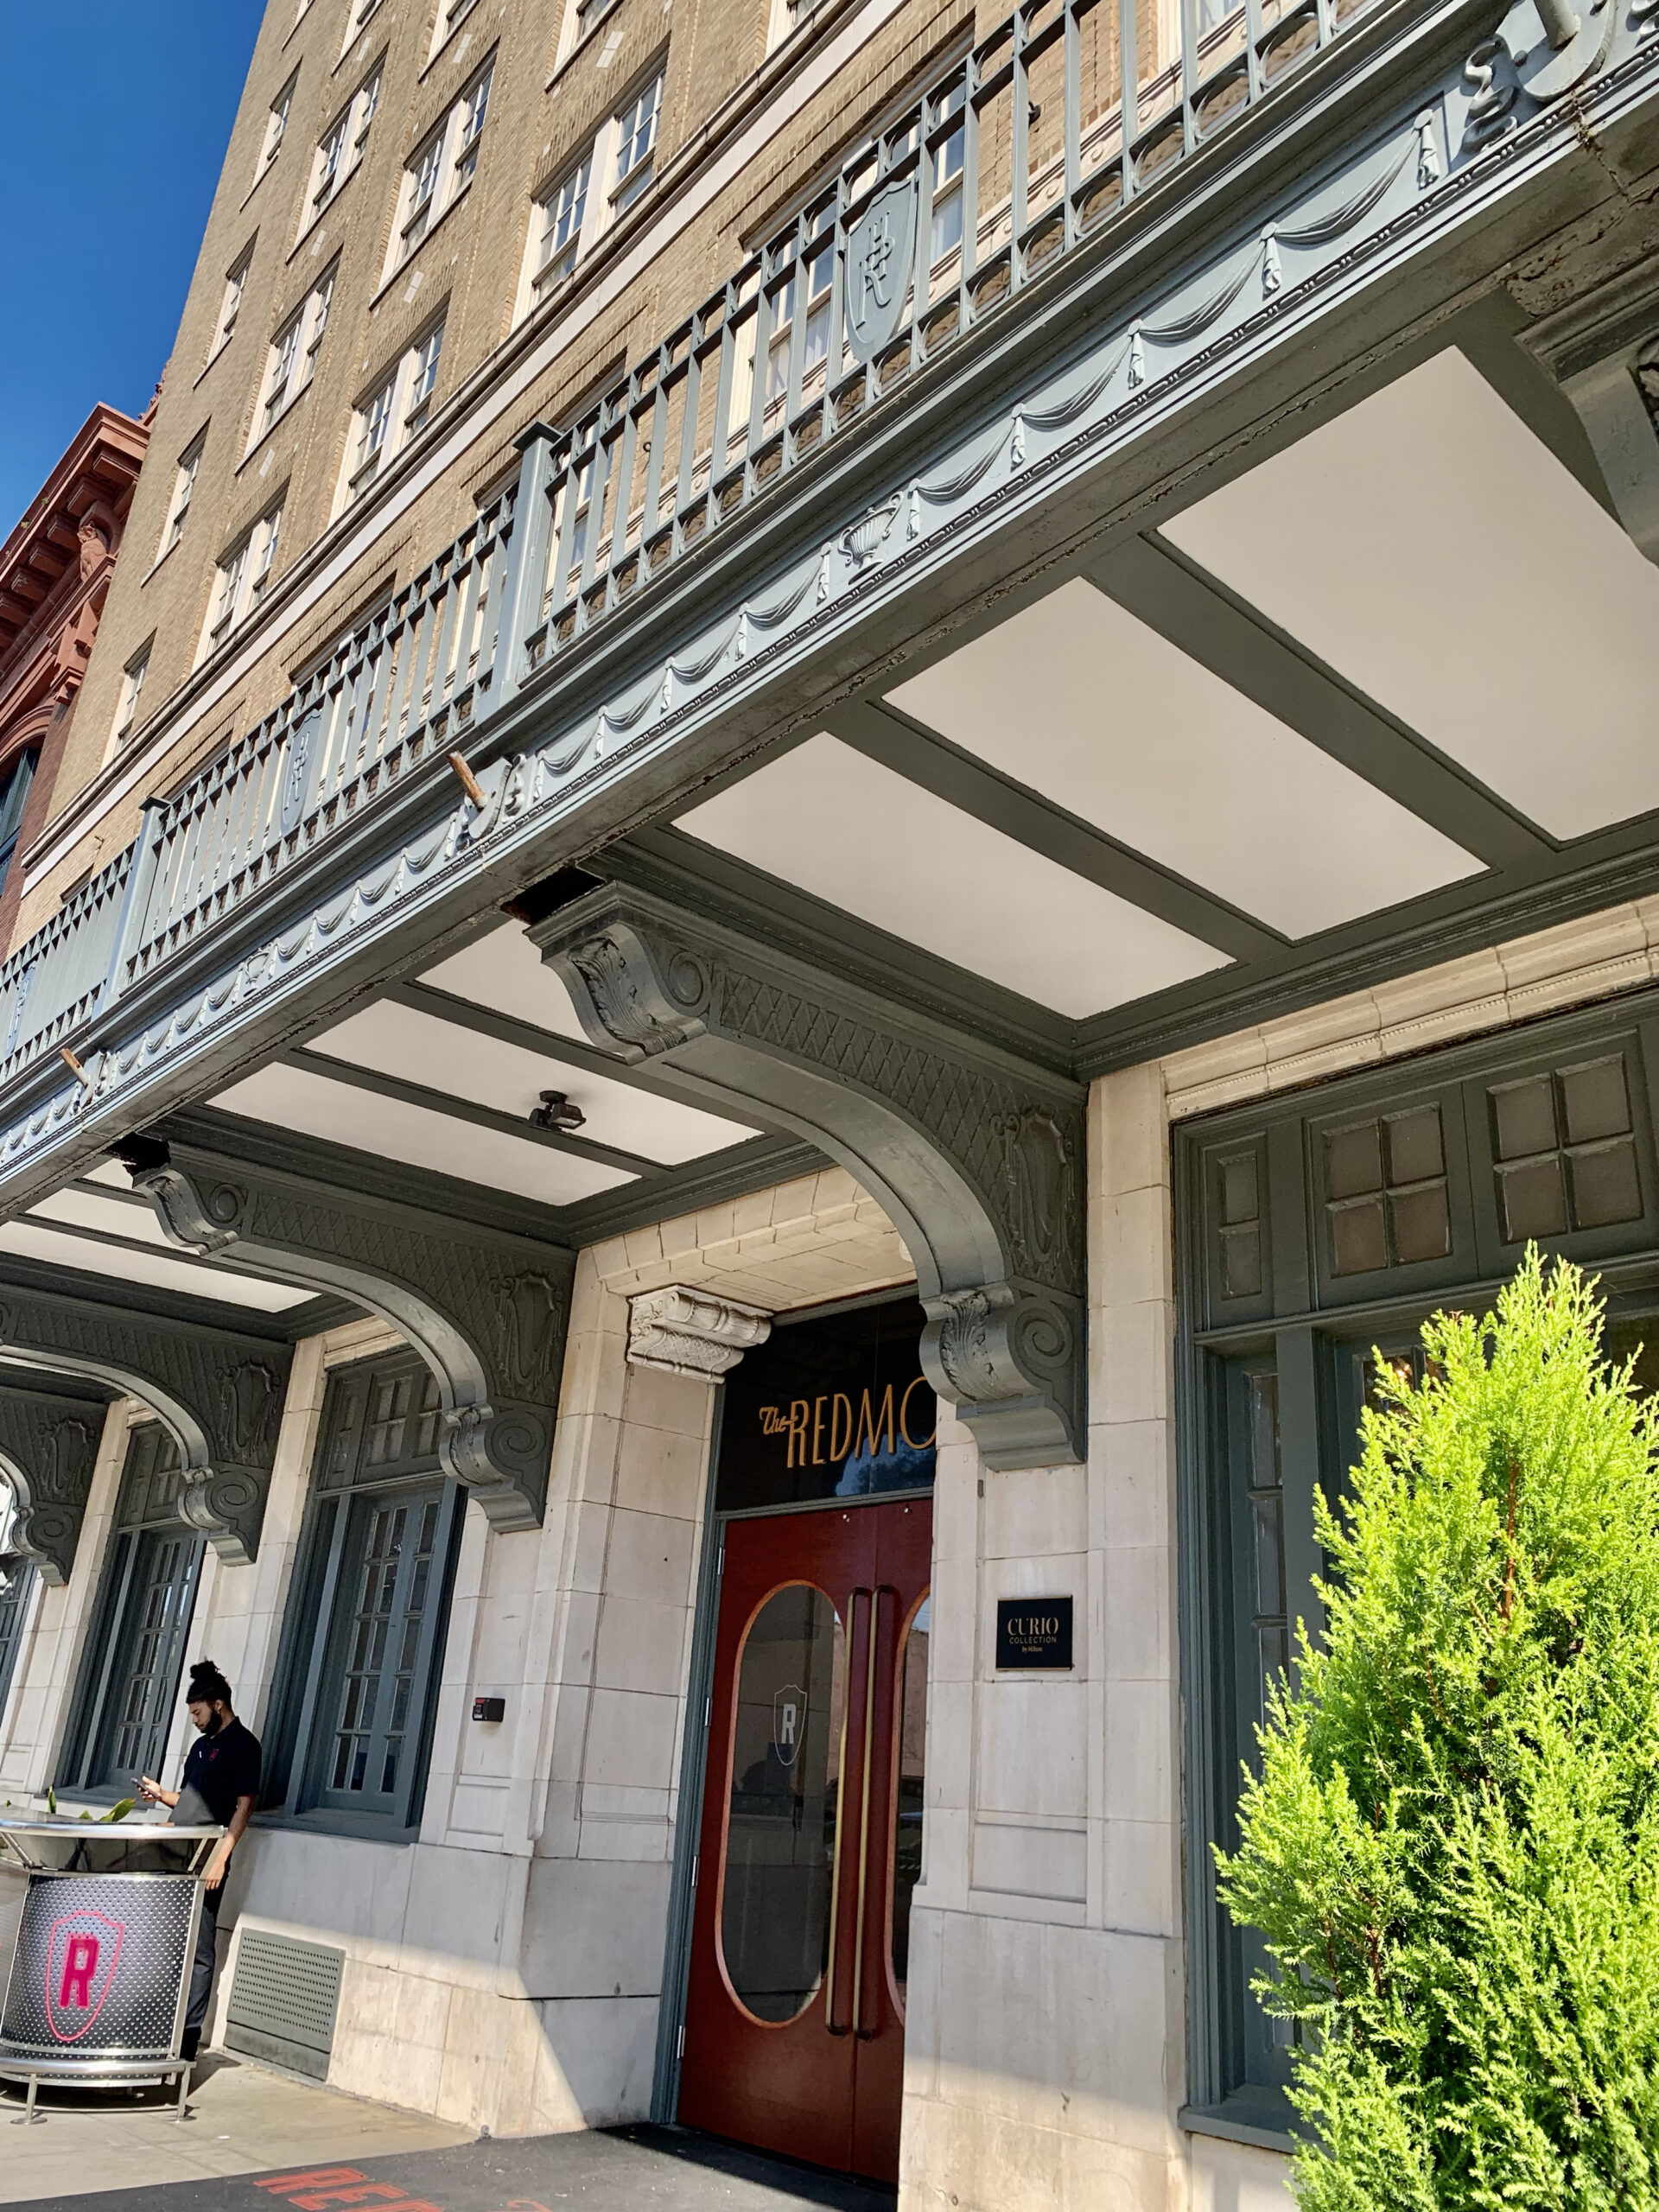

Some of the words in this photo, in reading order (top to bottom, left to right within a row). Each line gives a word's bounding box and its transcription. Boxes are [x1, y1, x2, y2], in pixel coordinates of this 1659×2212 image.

[760, 1406, 798, 1435] The
[1007, 1617, 1059, 1636] CURIO
[781, 1703, 797, 1744] R
[59, 1932, 100, 2010] R
